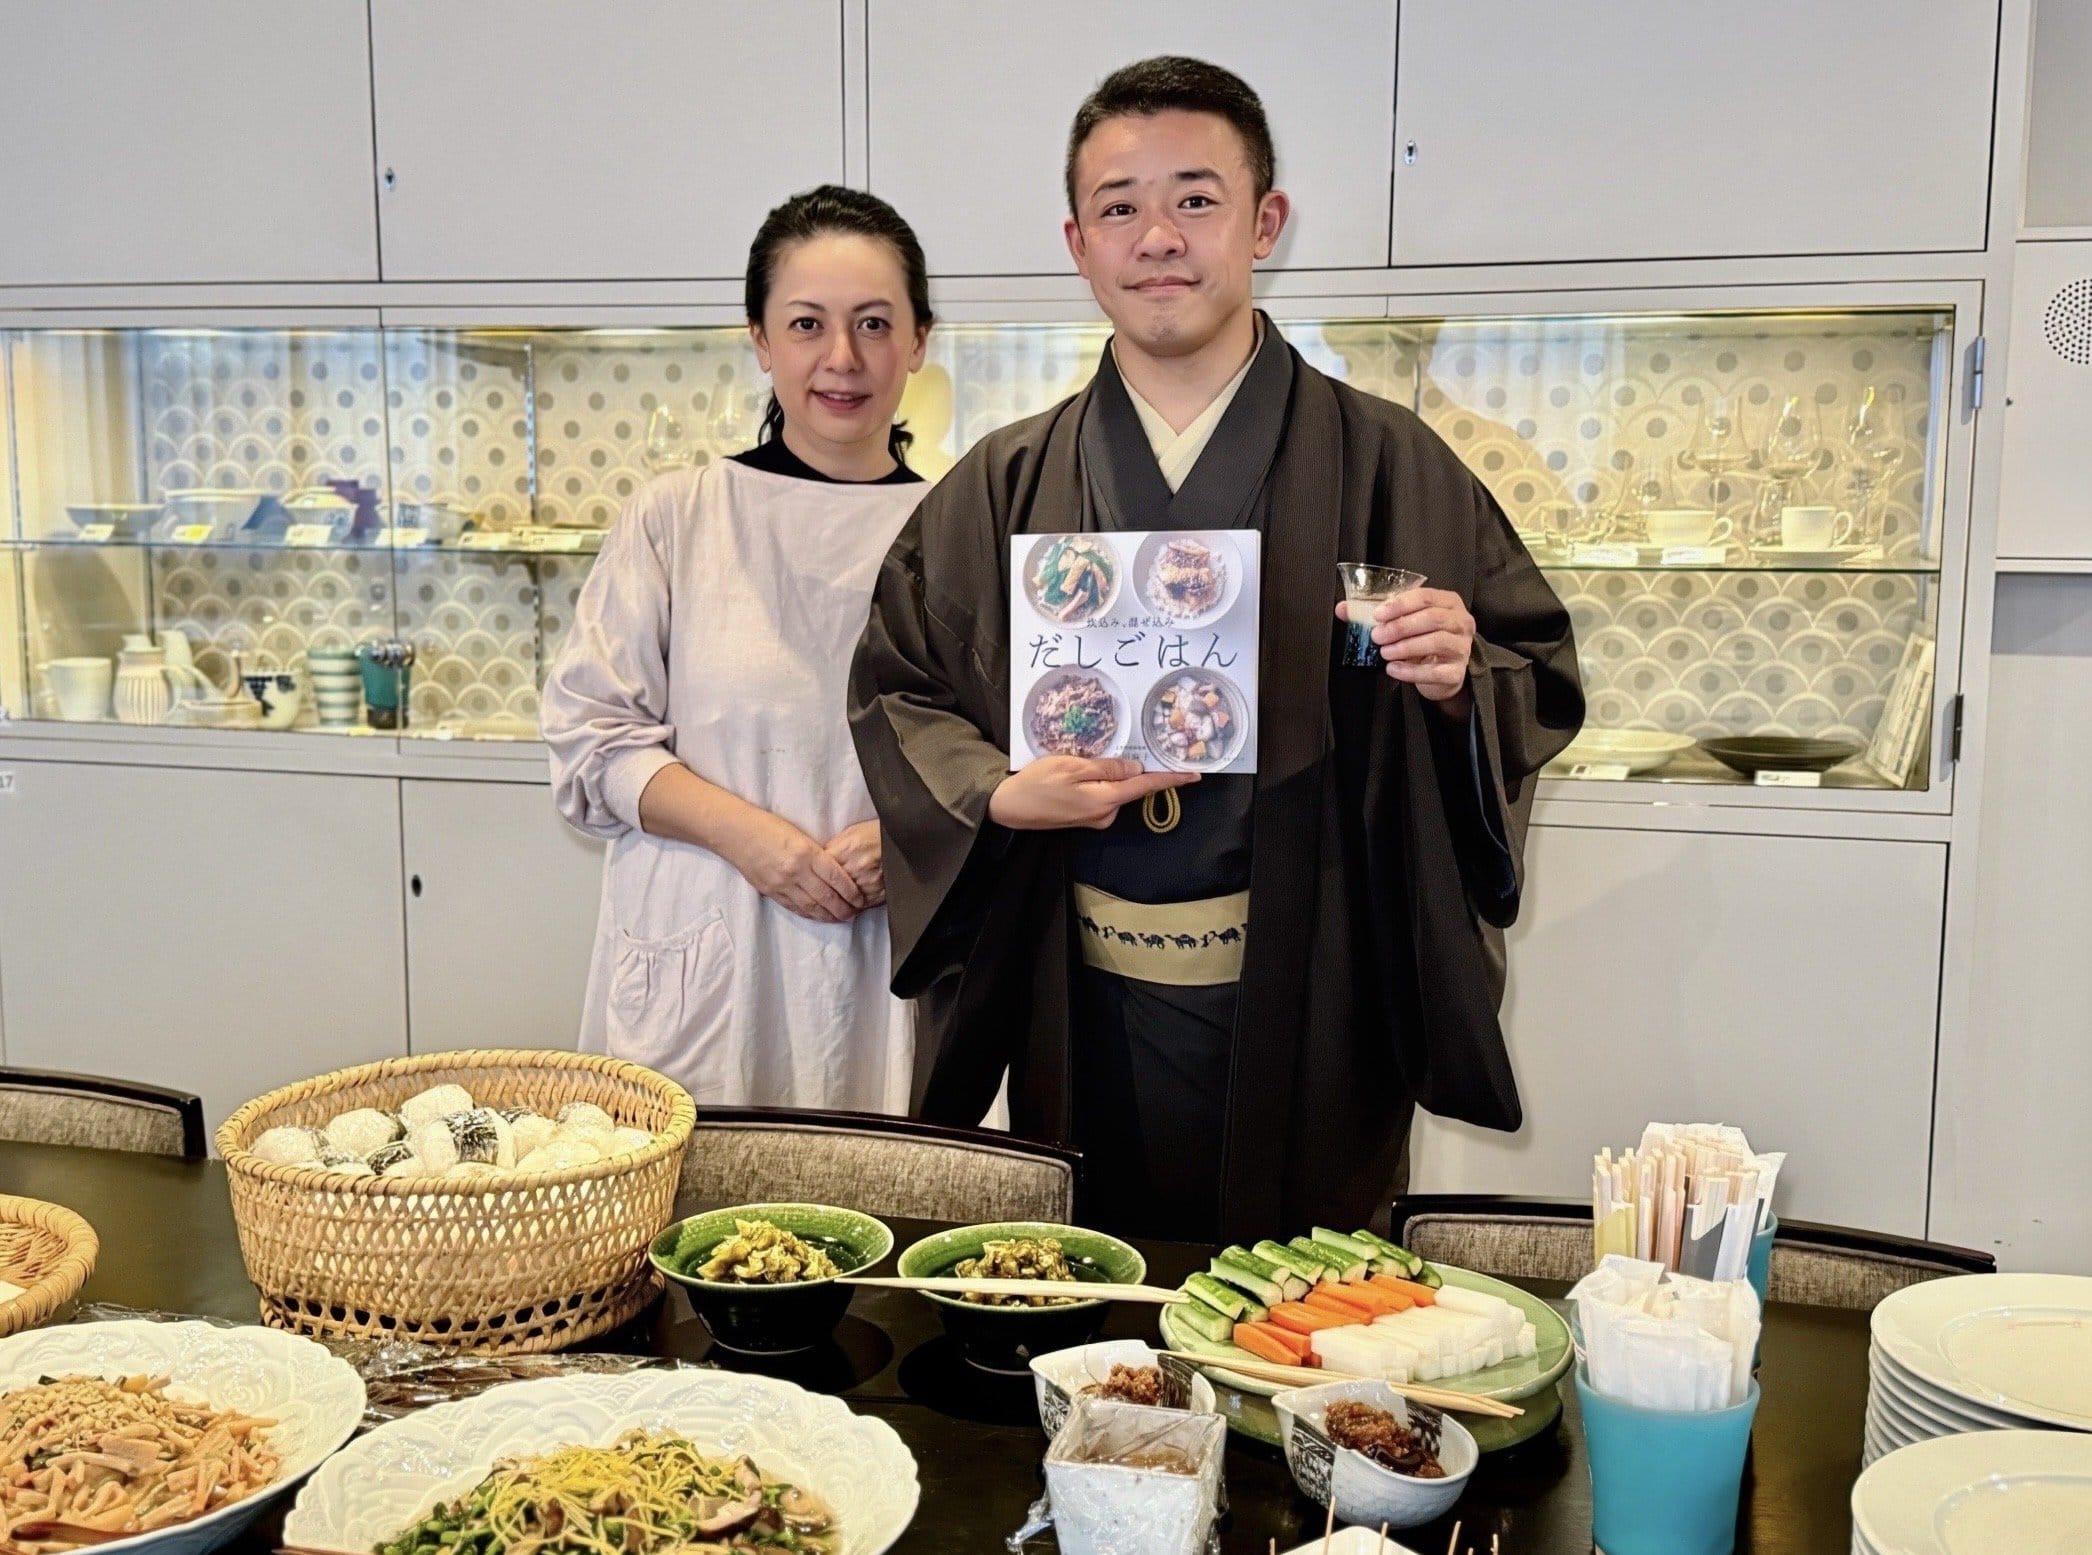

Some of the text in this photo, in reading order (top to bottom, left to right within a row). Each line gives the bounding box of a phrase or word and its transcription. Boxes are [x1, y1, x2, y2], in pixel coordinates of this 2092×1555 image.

[1029, 632, 1239, 669] だしごはん
